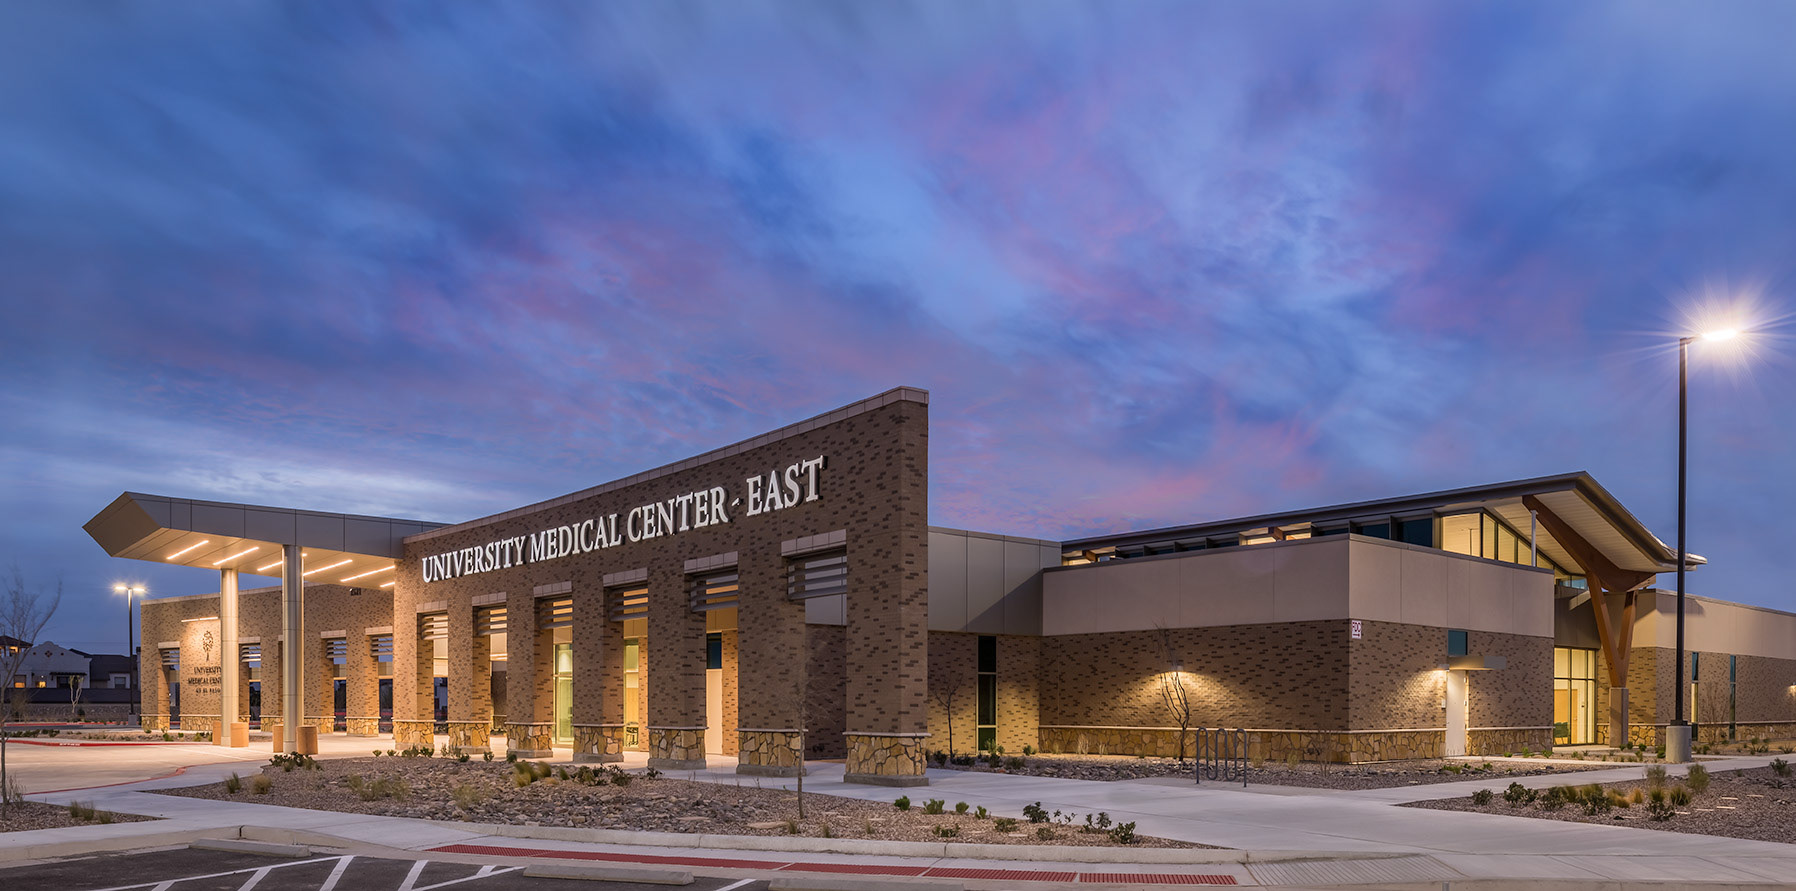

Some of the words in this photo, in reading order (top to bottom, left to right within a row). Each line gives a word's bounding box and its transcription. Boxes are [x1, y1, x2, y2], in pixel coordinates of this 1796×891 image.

[421, 535, 527, 583] UNIVERSITY
[529, 513, 623, 563] MEDICAL
[627, 486, 730, 543] CENTER
[746, 454, 826, 517] EAST
[188, 677, 209, 685] MEDICAL
[209, 677, 222, 685] CENT
